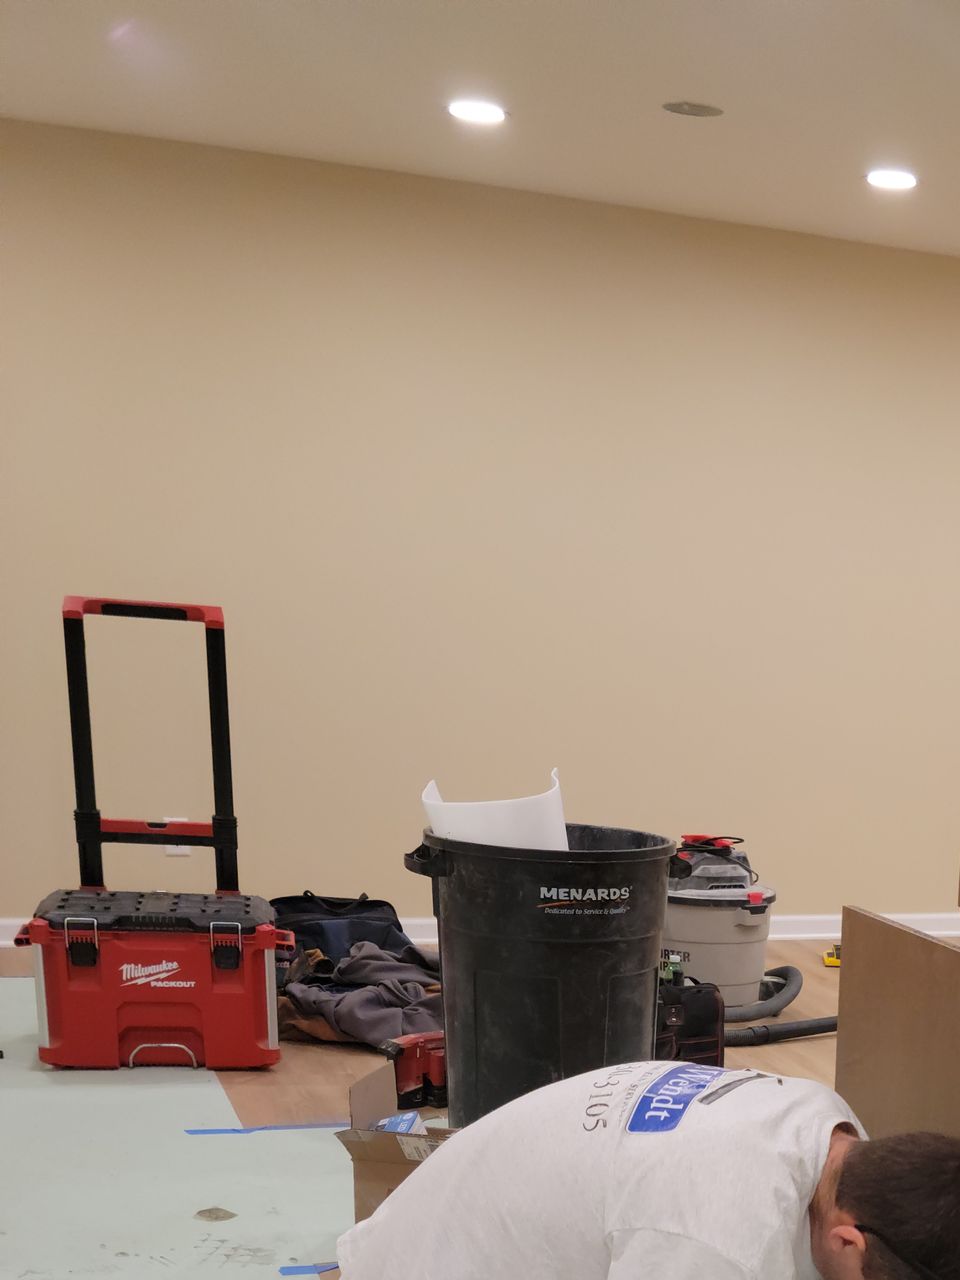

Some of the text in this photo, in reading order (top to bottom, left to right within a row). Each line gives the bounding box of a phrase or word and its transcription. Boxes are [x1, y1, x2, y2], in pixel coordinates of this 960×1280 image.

[540, 886, 630, 901] MENARDS
[575, 907, 583, 915] to
[118, 960, 180, 981] Milwaukee
